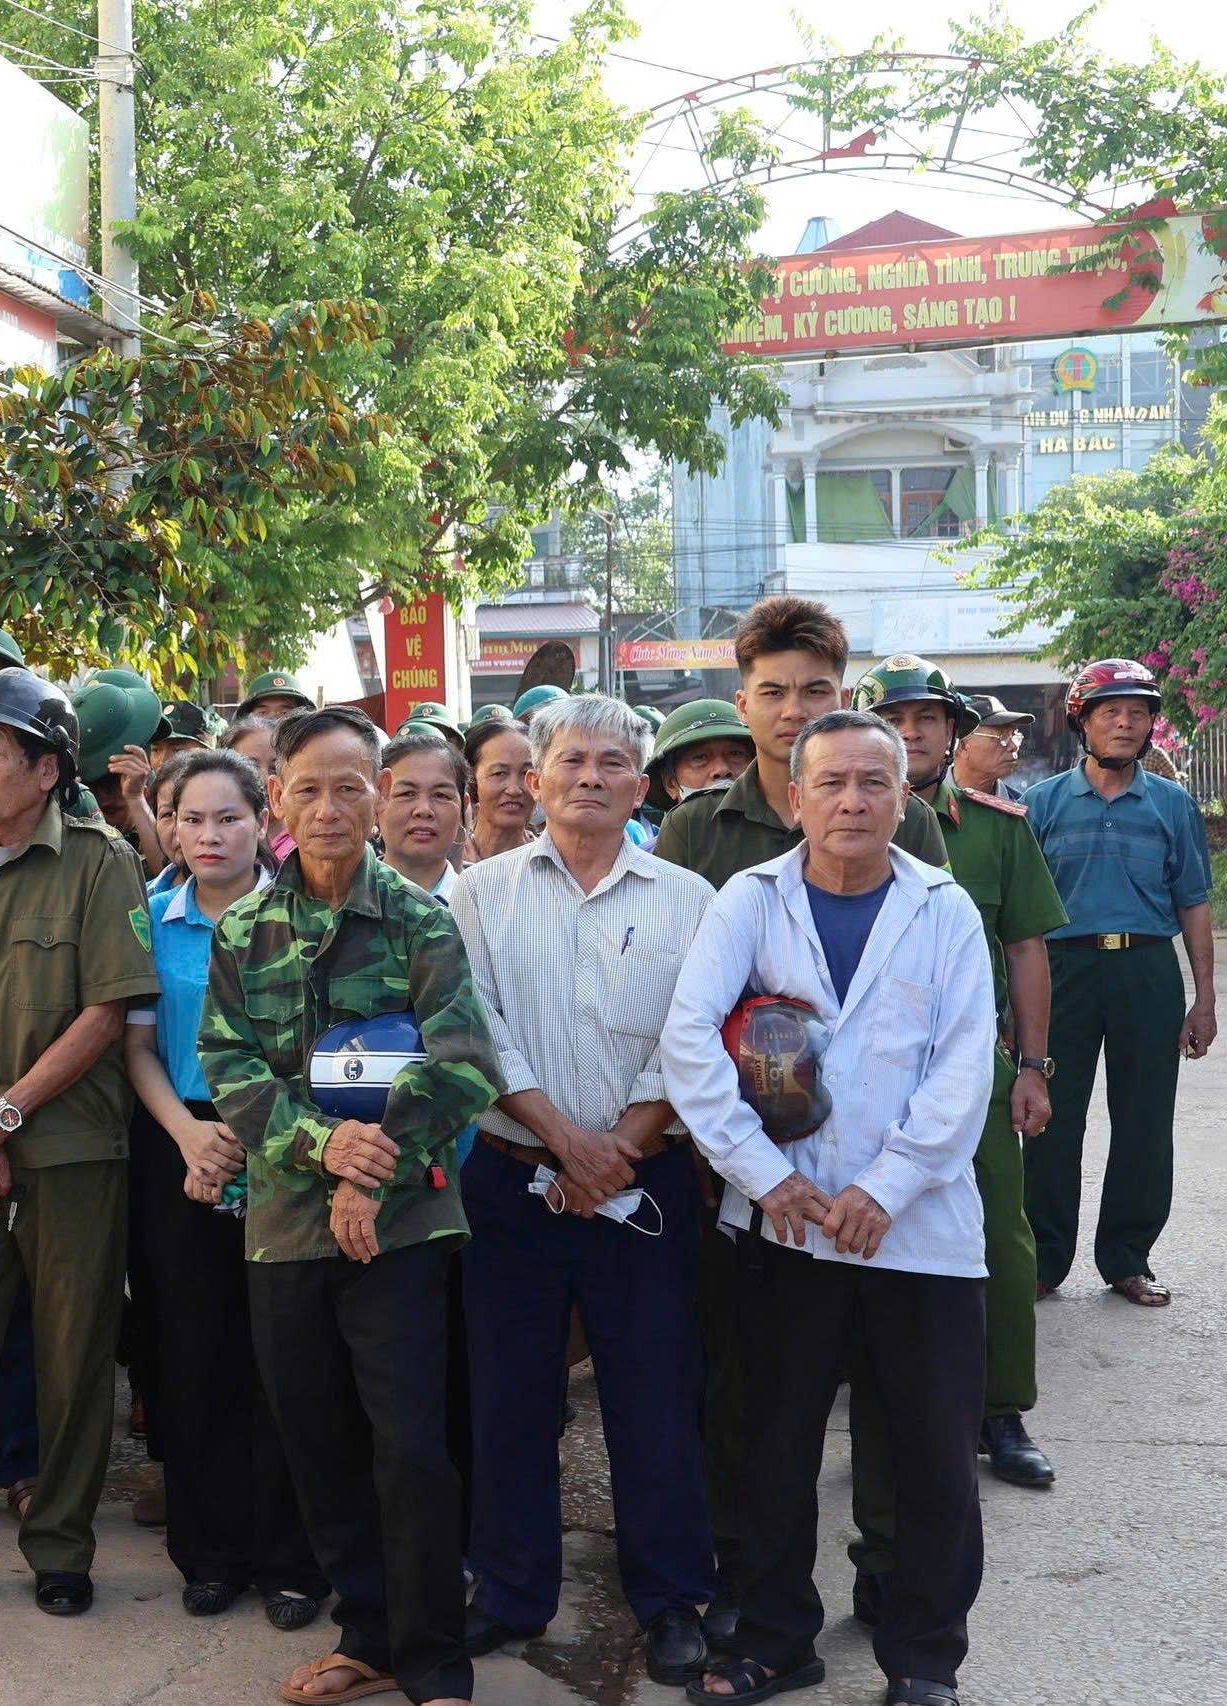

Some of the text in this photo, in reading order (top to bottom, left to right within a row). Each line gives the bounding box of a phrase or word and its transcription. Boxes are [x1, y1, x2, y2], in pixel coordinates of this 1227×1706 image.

[868, 256, 930, 291] NGHĨA
[934, 252, 988, 284] TÌNH,
[993, 247, 1061, 280] TRUNG
[794, 301, 820, 338] KỶ
[824, 305, 898, 336] CƯƠNG,
[903, 297, 958, 329] SÁNG
[964, 296, 1002, 329] TẠO
[1009, 295, 1016, 321] !
[405, 634, 422, 661] VỆ
[392, 666, 438, 689] CHÚNG
